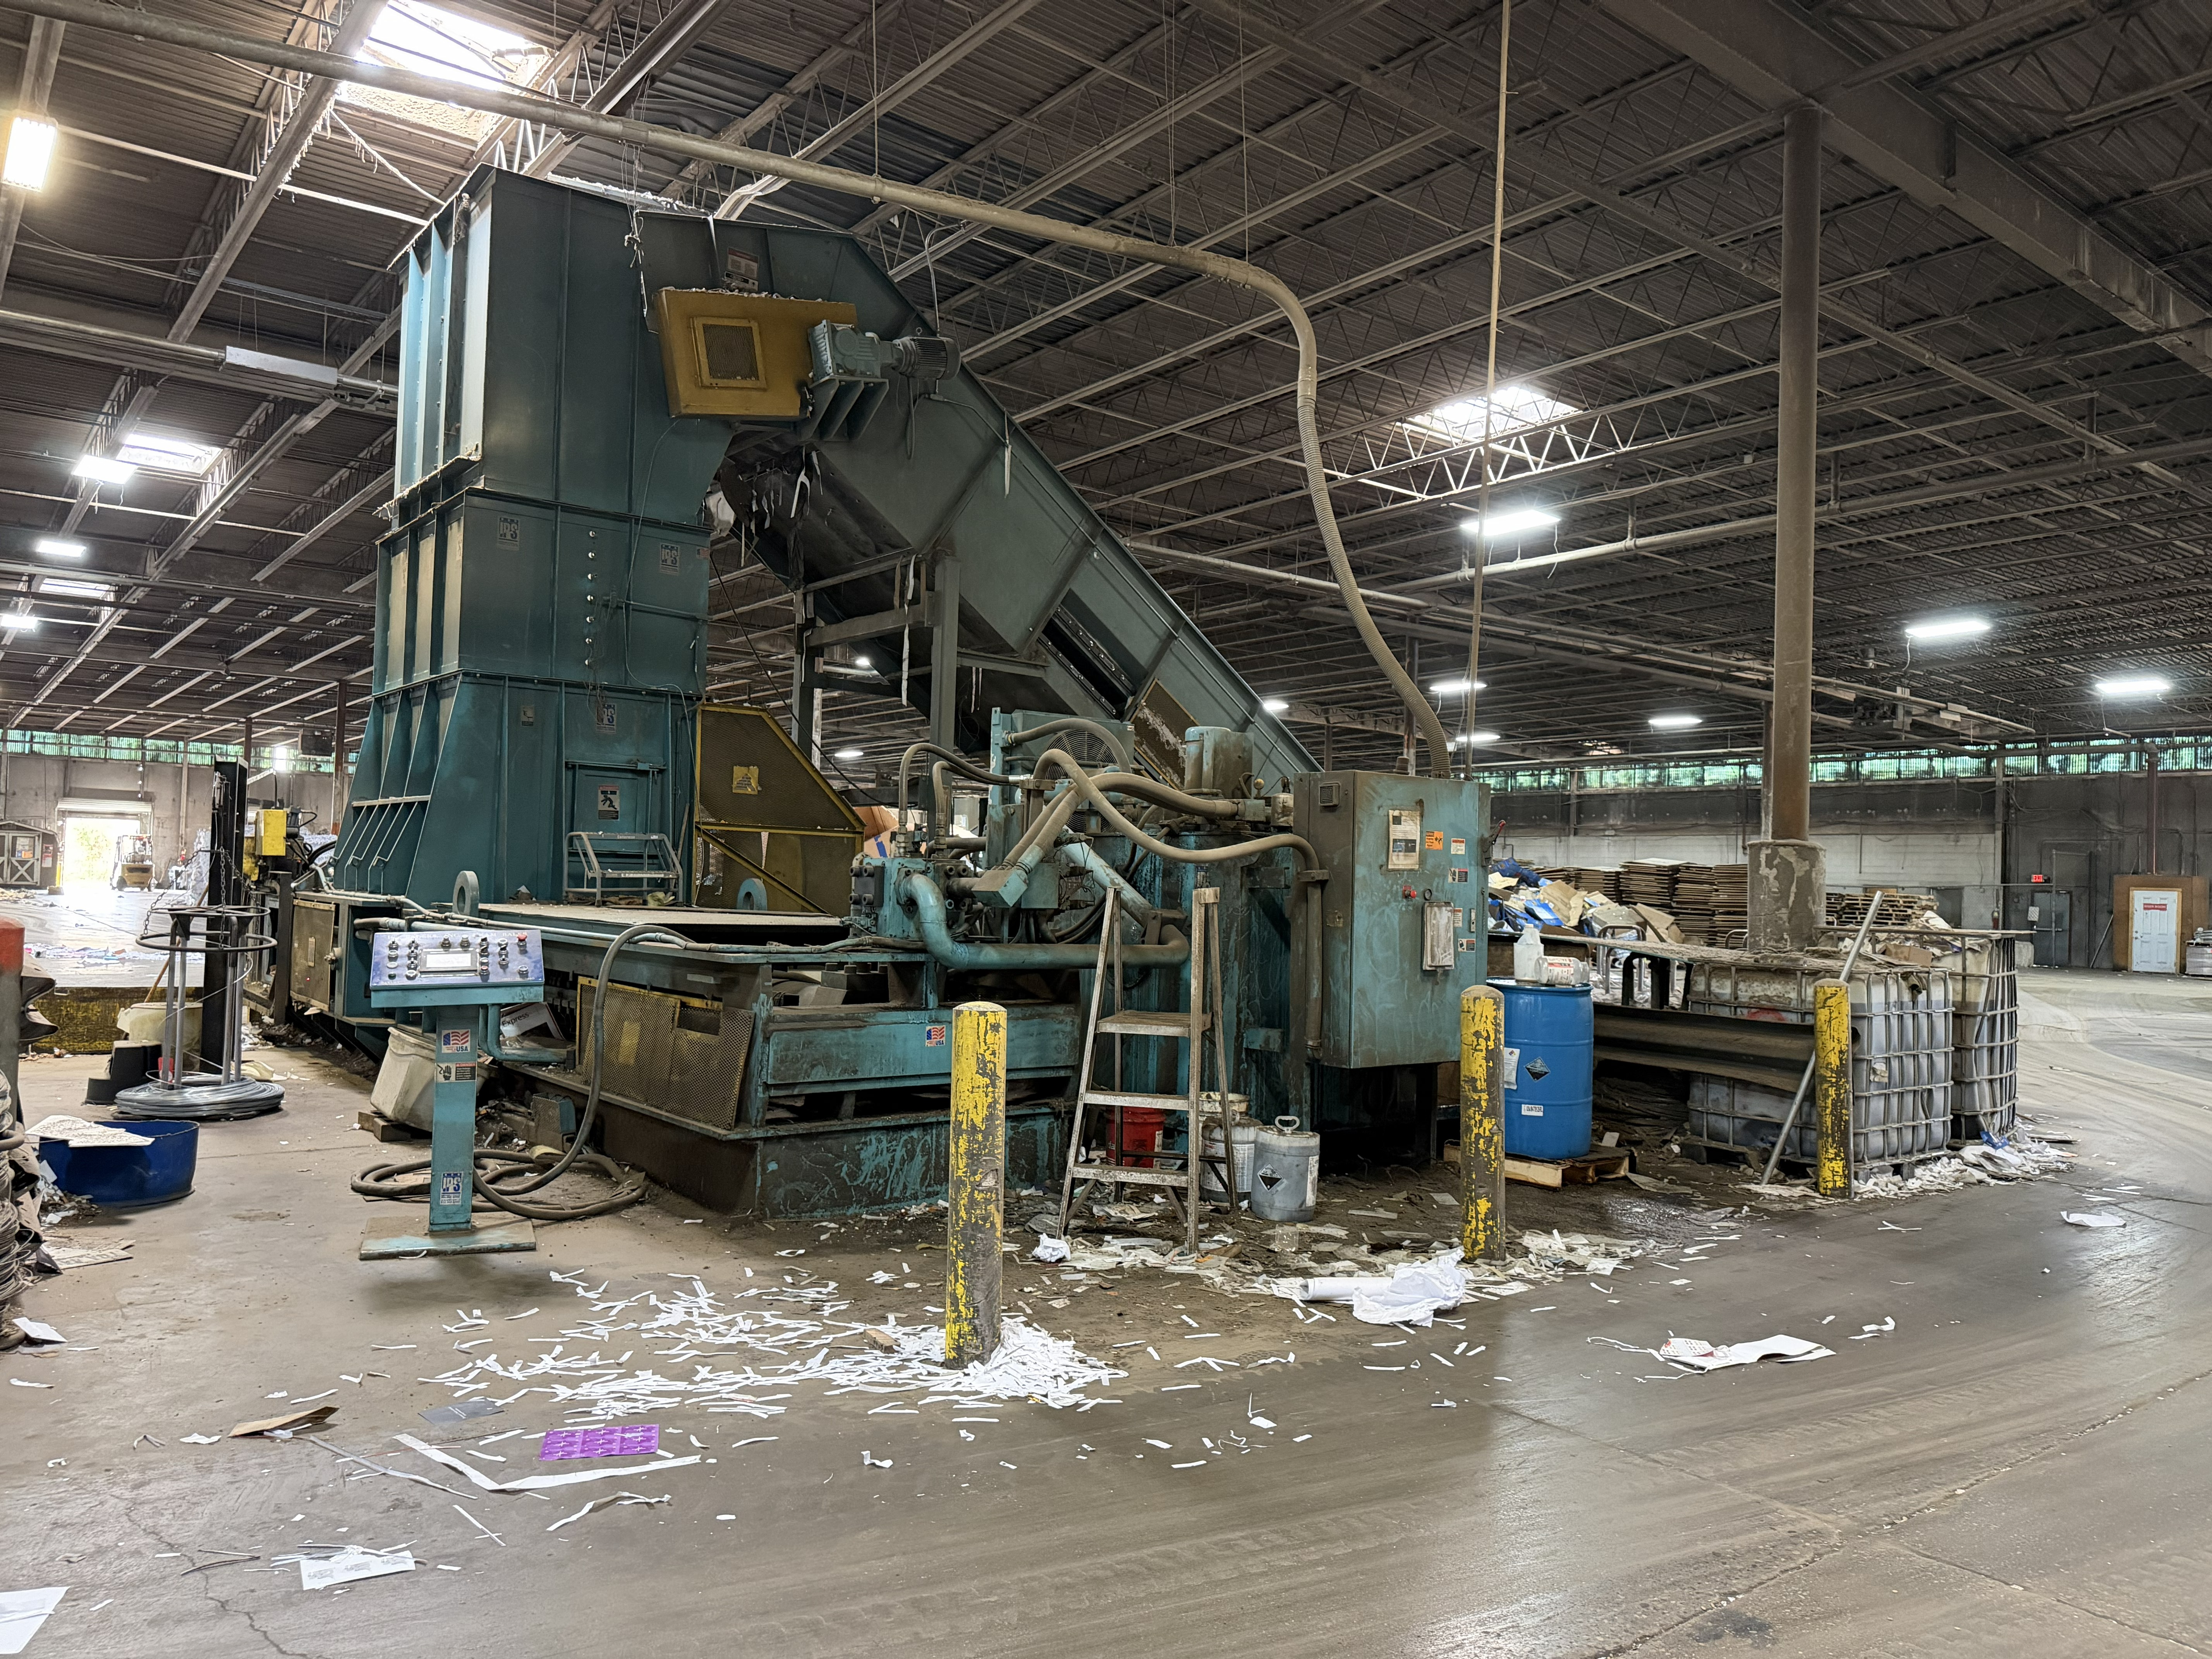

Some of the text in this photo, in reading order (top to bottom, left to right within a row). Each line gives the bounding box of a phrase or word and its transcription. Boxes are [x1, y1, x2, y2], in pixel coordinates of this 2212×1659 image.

[500, 522, 518, 539] IPS
[661, 549, 678, 565] IPS
[501, 1012, 529, 1027] Express
[442, 1177, 461, 1192] IPS
